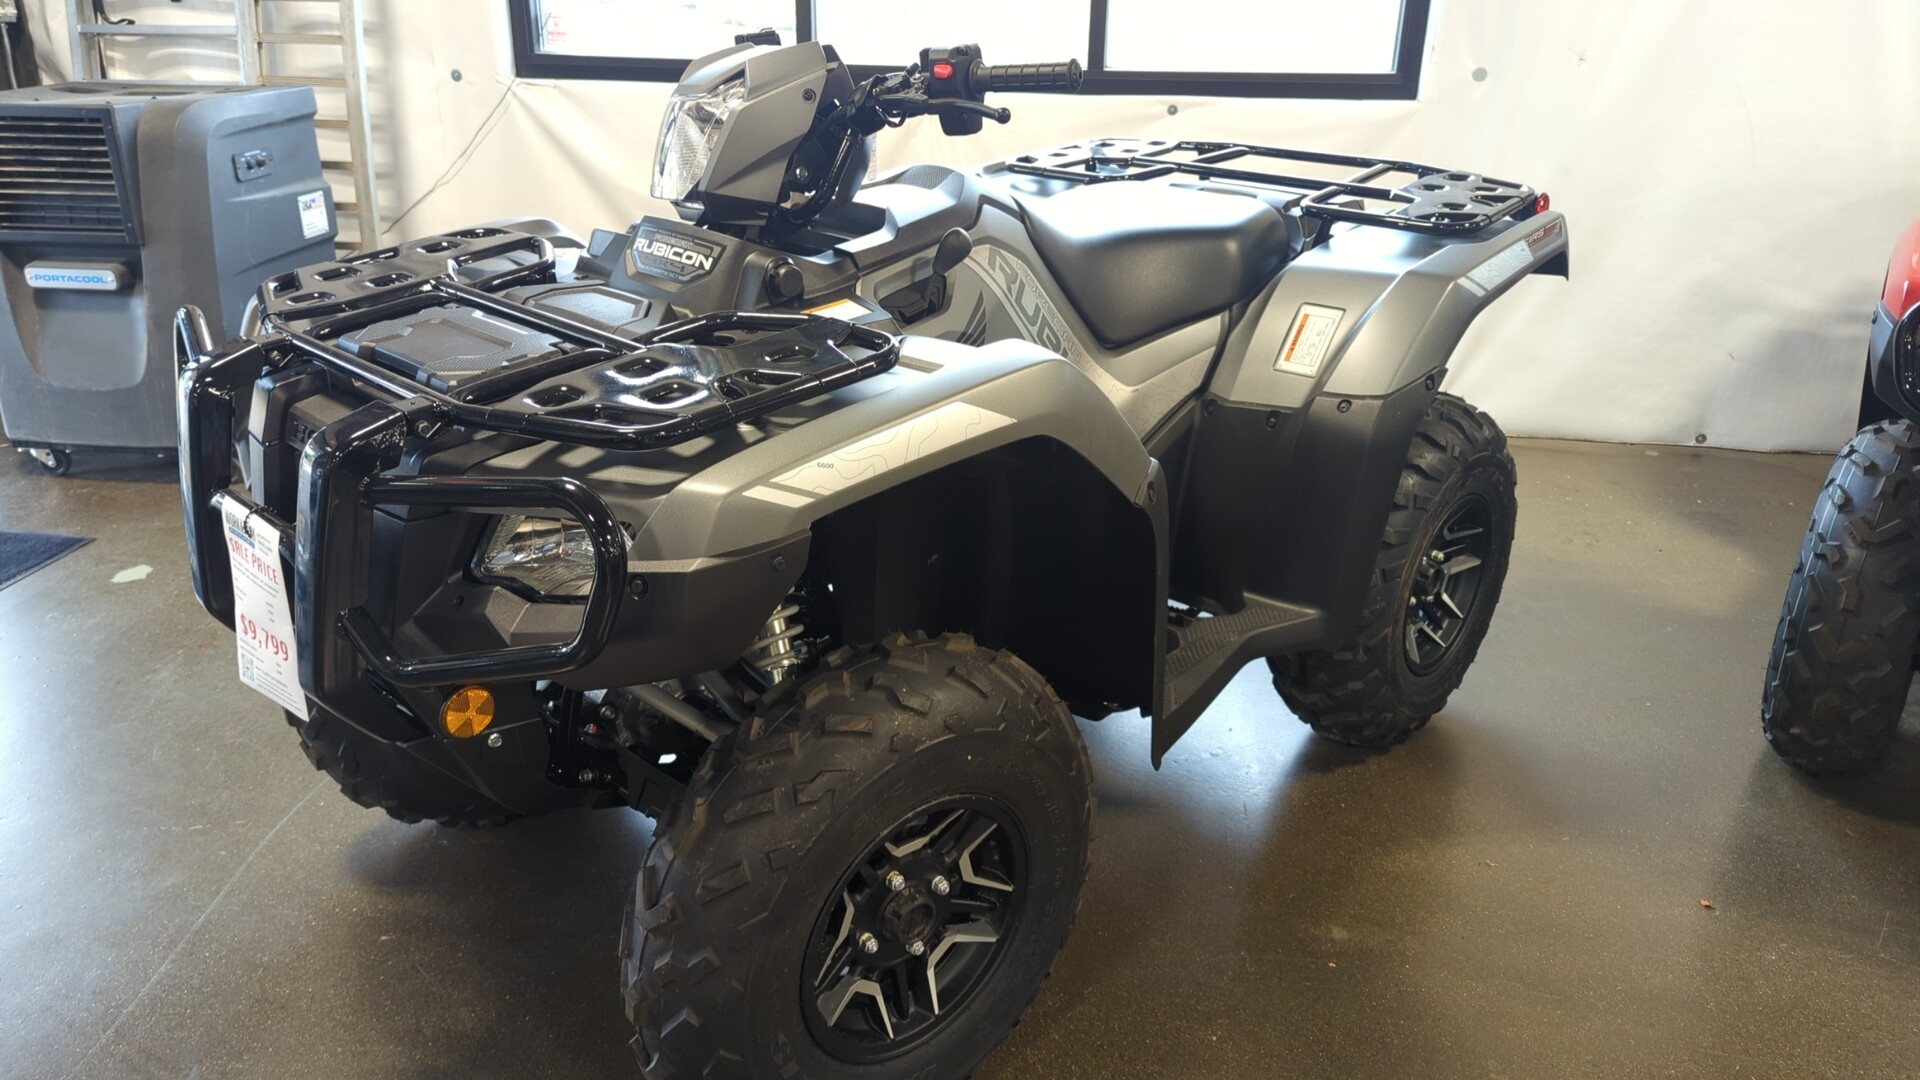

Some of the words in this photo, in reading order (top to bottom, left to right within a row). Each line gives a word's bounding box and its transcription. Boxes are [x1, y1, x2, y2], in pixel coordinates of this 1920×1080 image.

[633, 237, 714, 271] RUBICON
[34, 273, 108, 284] PORTACOOL
[229, 537, 250, 564] SALE
[251, 553, 280, 586] PRICE
[240, 613, 289, 662] $9,799
